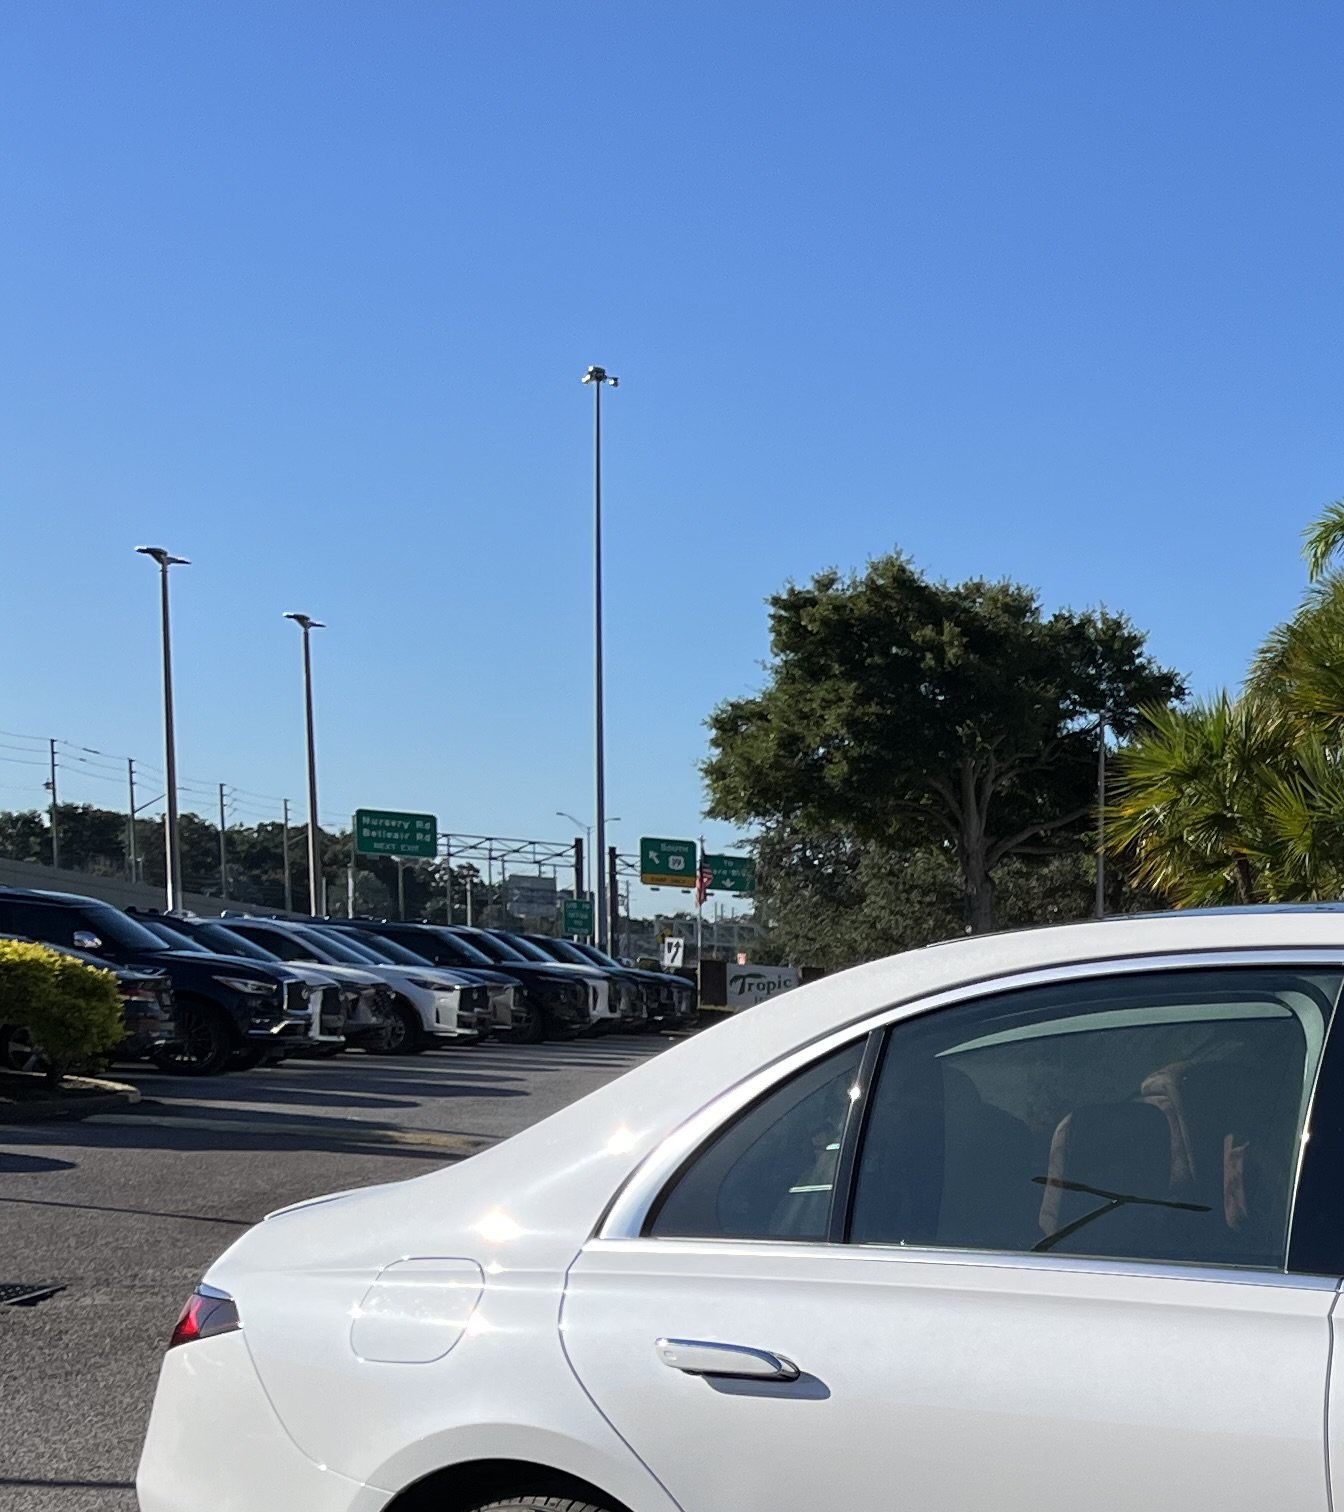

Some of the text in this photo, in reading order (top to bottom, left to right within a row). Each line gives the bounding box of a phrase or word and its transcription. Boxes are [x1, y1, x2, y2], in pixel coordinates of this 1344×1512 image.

[362, 816, 431, 830] Nursery Rd
[416, 832, 431, 842] Rd
[729, 973, 792, 995] Tropic
